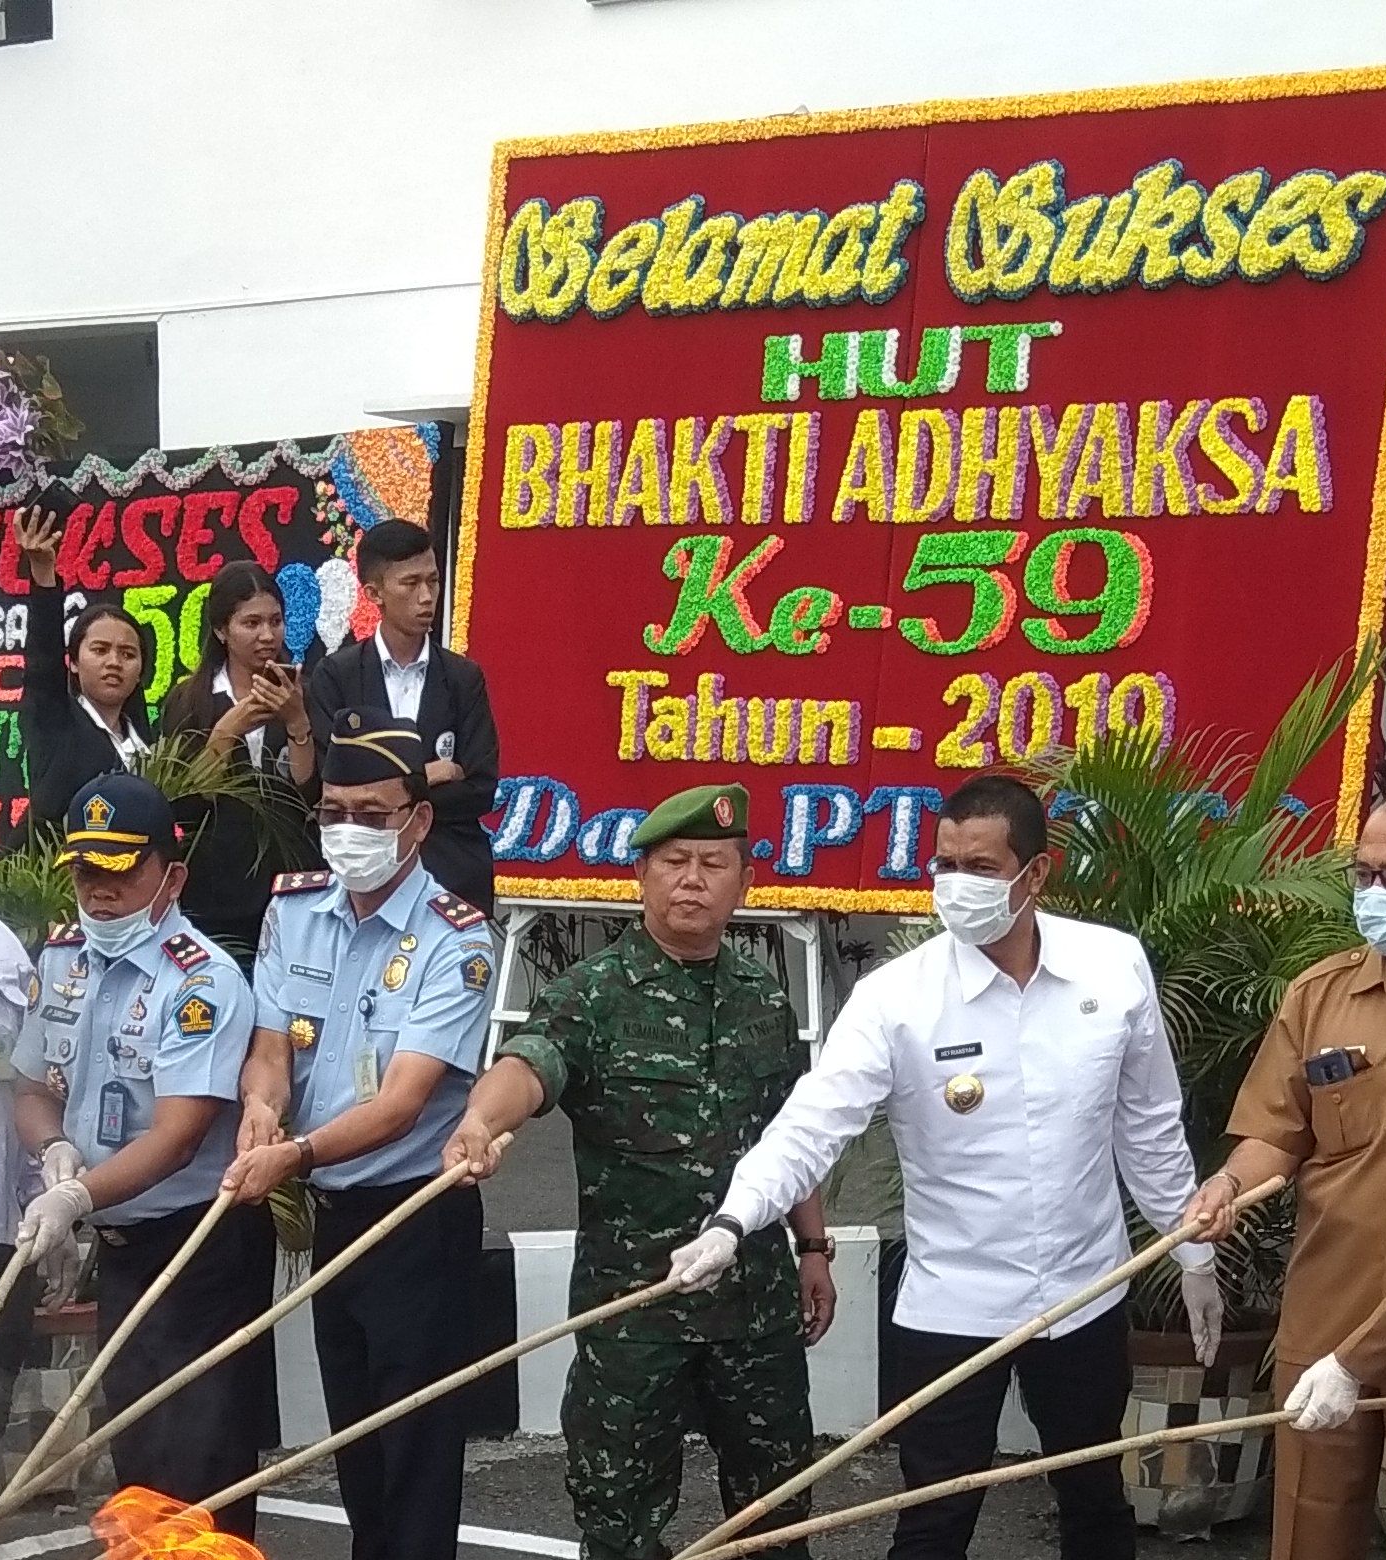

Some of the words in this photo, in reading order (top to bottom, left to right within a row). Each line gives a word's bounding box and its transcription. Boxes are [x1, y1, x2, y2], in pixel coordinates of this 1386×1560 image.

[499, 178, 925, 324] Selamat
[761, 322, 1064, 402] HUT
[501, 411, 821, 531] BHAKTI
[831, 395, 1334, 527] ADHYAKSA
[644, 528, 1155, 657] Ke-59
[605, 670, 863, 767] Tahun
[935, 671, 1178, 769] 2019
